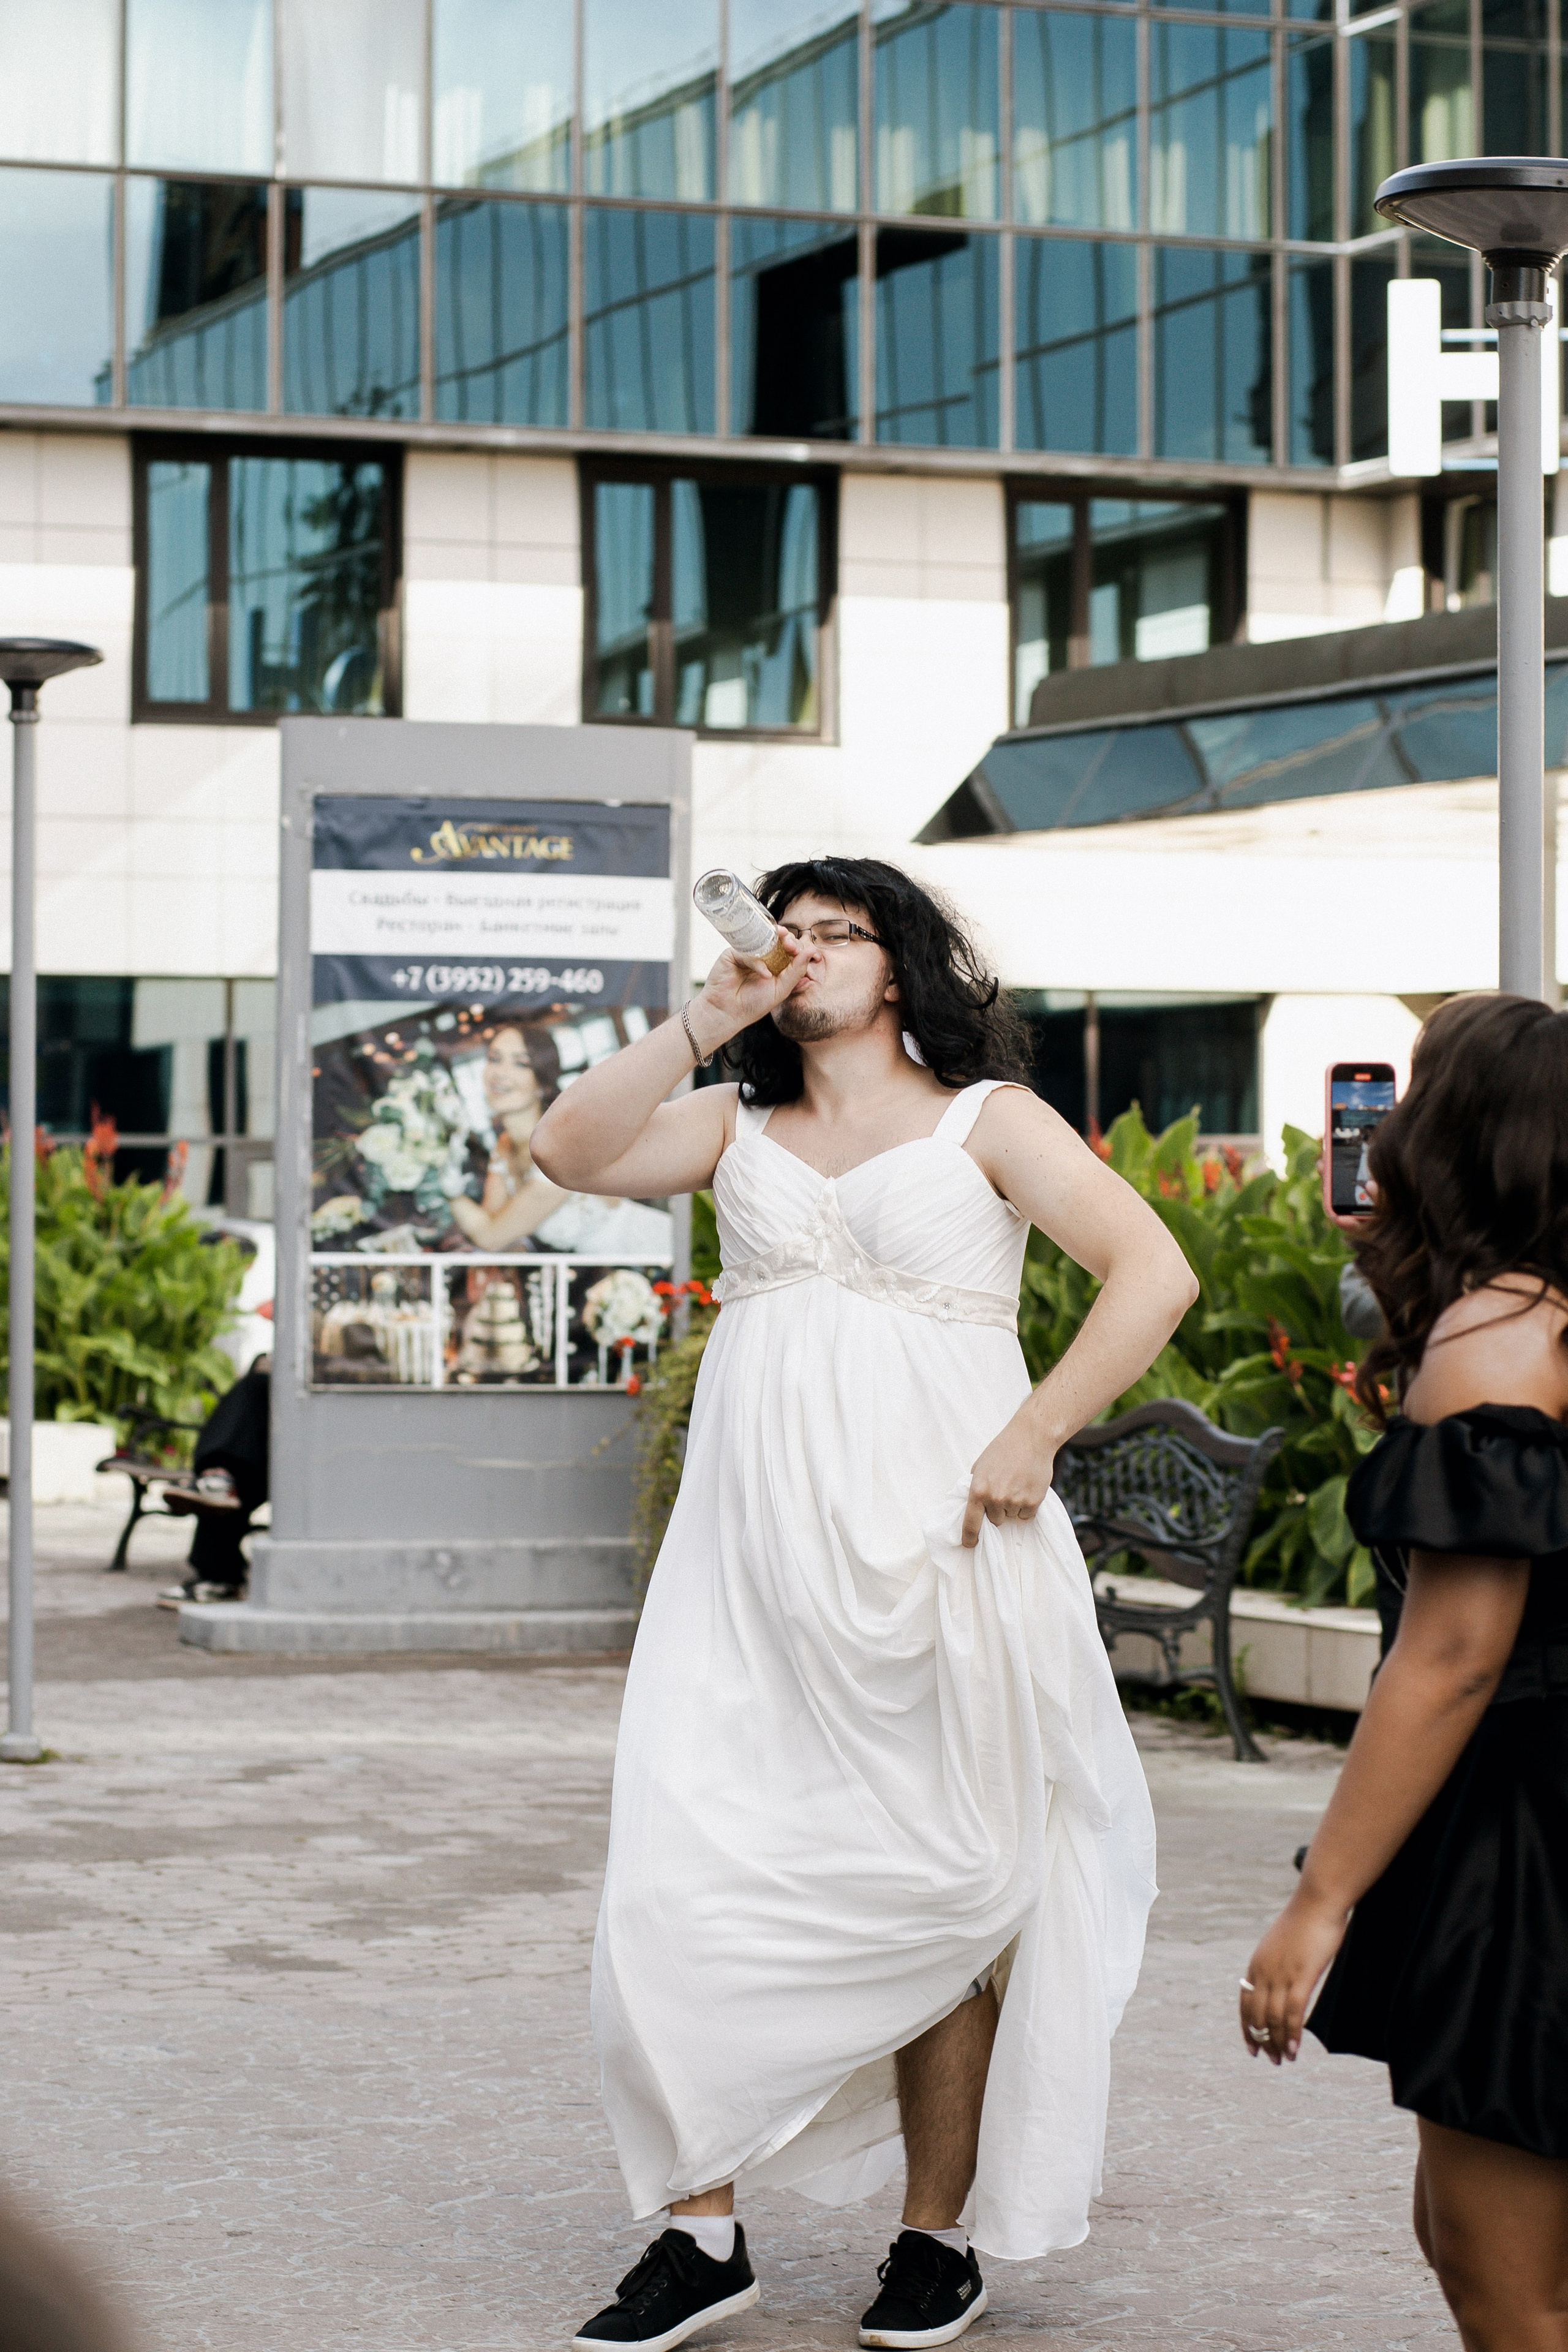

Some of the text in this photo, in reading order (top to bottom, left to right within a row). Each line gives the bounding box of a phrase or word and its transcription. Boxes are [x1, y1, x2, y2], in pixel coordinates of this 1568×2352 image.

[391, 964, 605, 995] +7 (3952) 259-460
